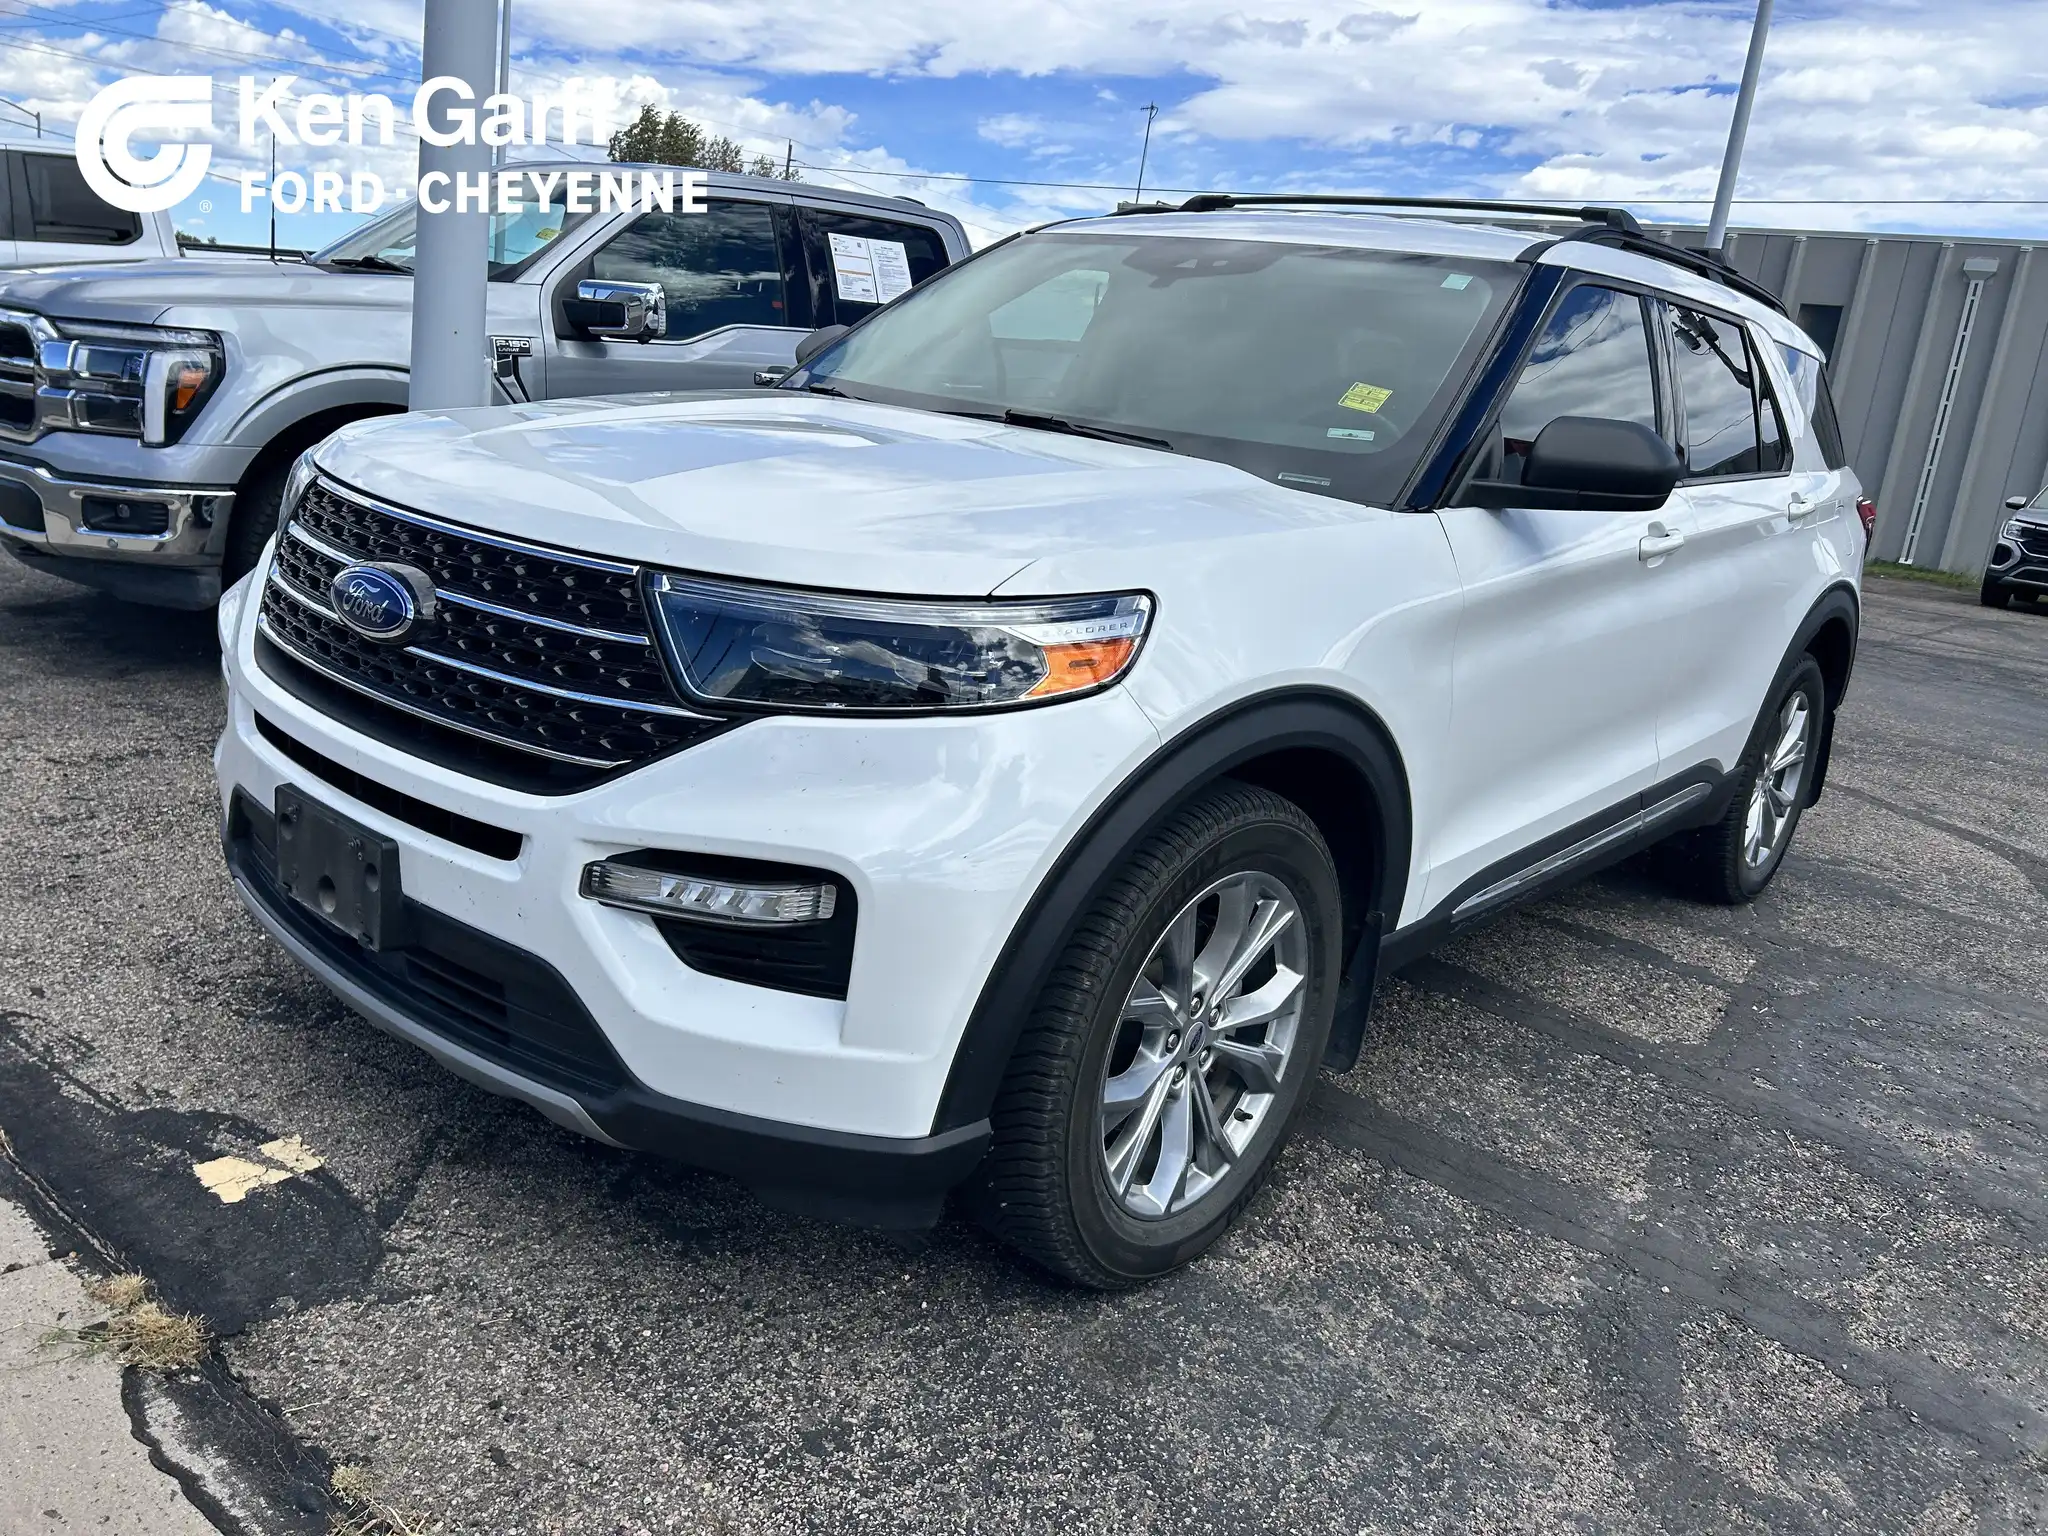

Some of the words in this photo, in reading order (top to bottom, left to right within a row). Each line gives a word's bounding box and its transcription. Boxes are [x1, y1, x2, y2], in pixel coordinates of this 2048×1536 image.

[496, 340, 529, 348] F-150
[343, 579, 389, 623] Ford
[1042, 622, 1128, 637] EPLORER
